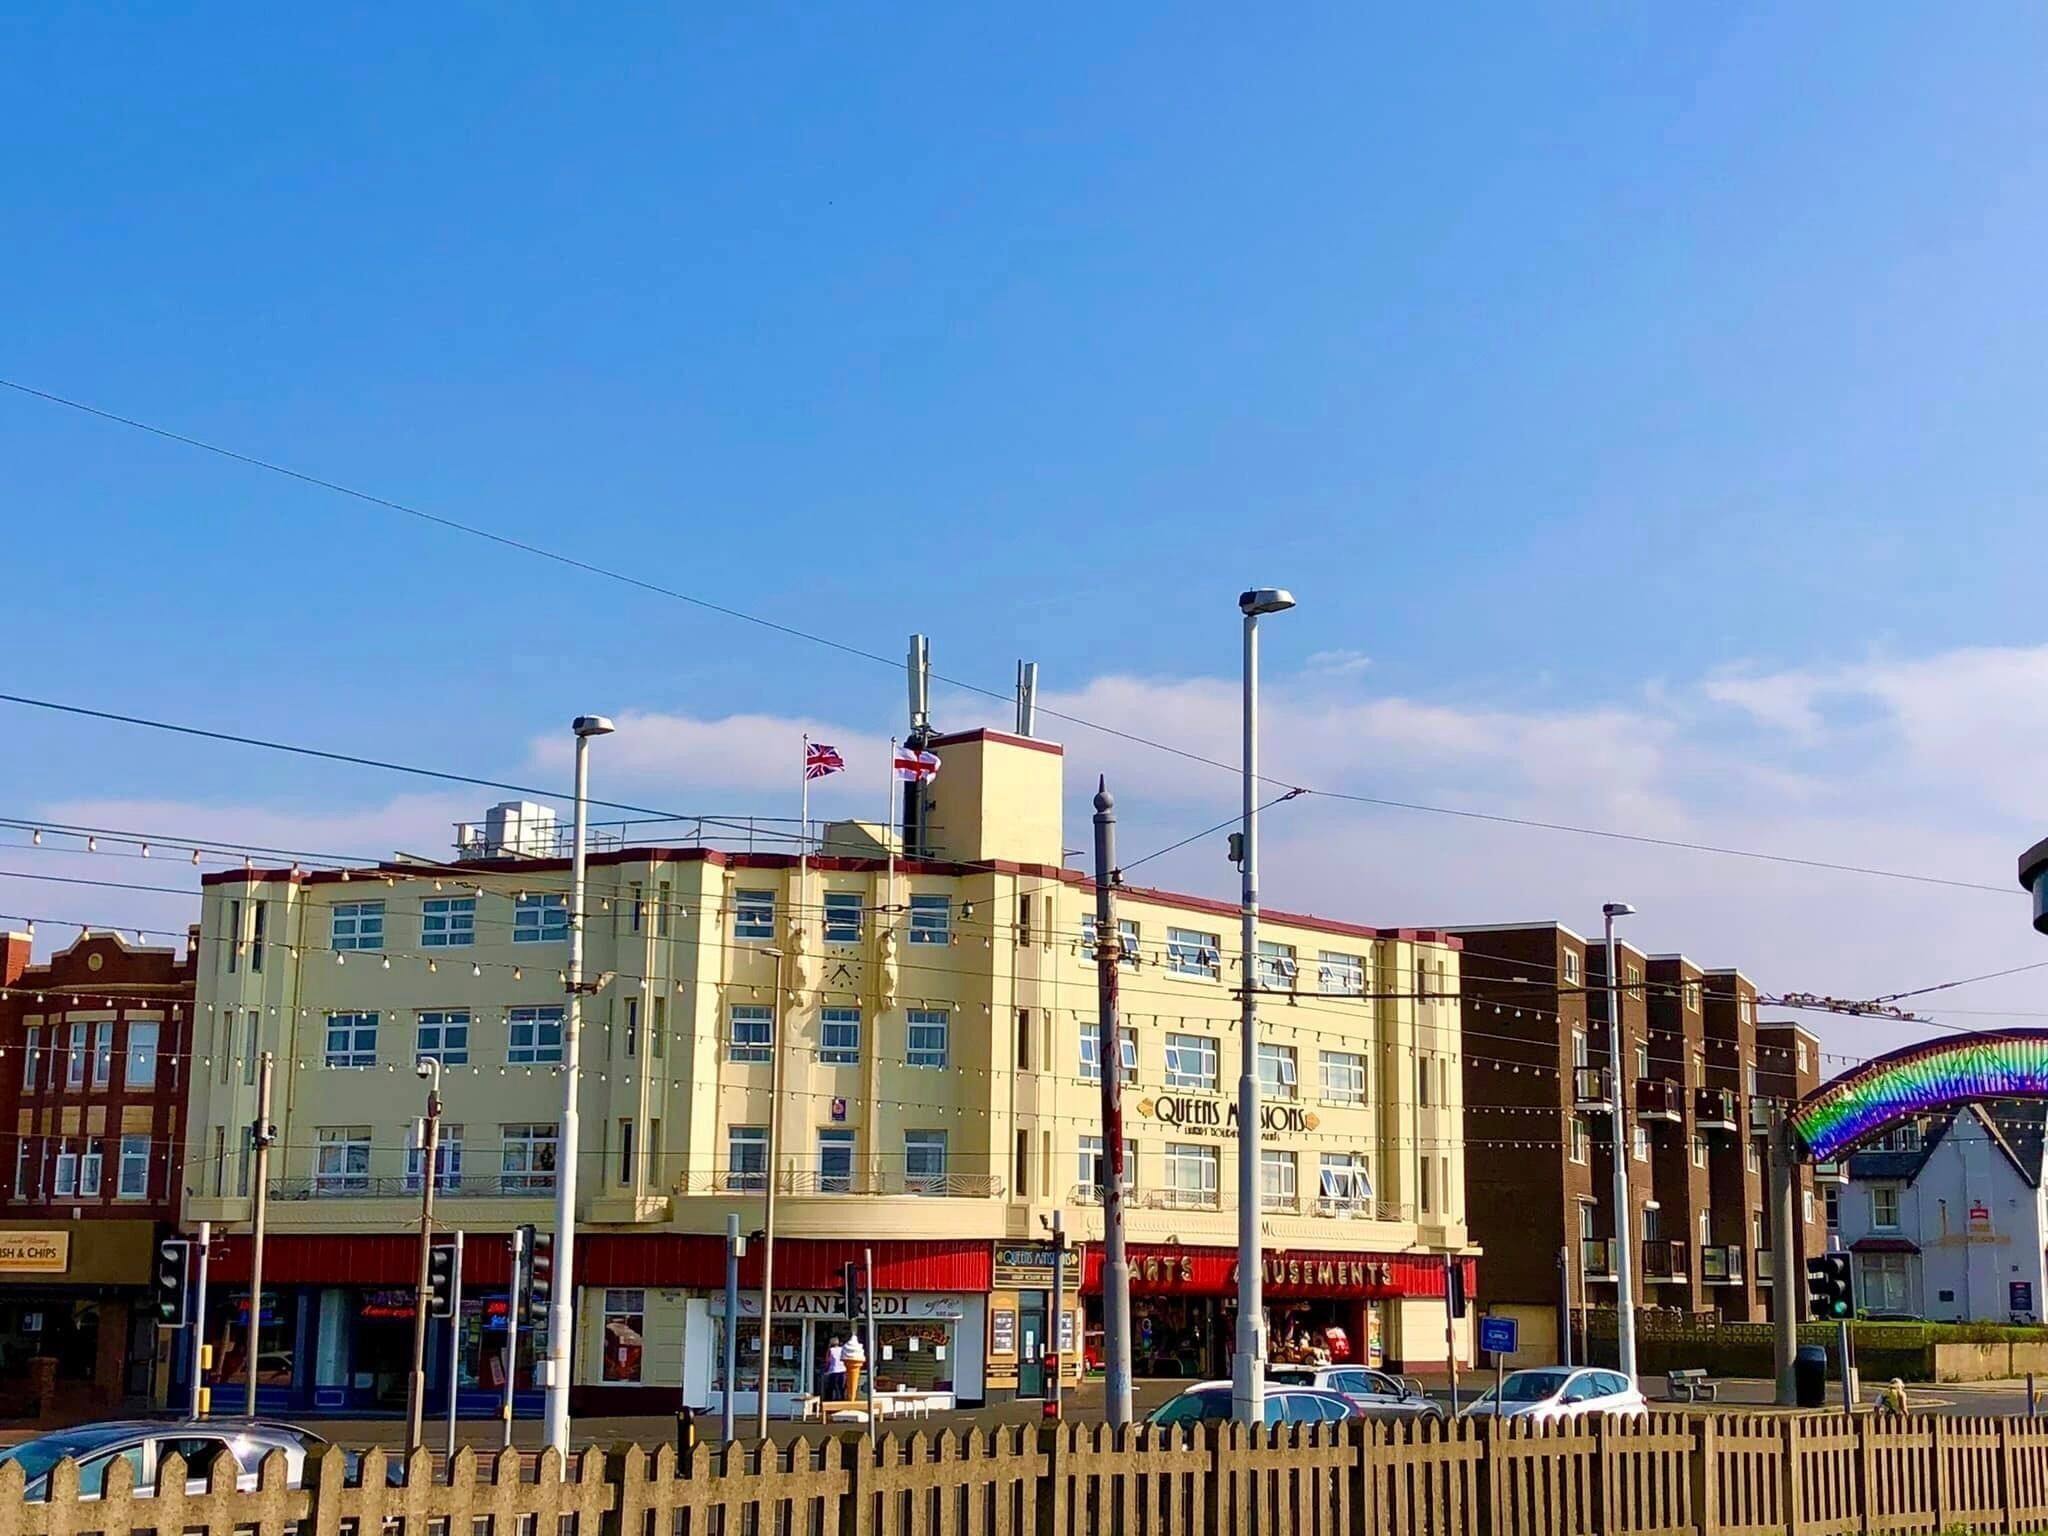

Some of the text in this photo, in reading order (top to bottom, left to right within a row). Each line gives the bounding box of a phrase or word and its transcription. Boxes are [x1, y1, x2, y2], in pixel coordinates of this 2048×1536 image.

[1155, 1096, 1305, 1132] QUEENS MSIONS
[17, 1247, 24, 1258] &
[27, 1247, 57, 1258] CHIPS
[1128, 1256, 1193, 1282] ARTS
